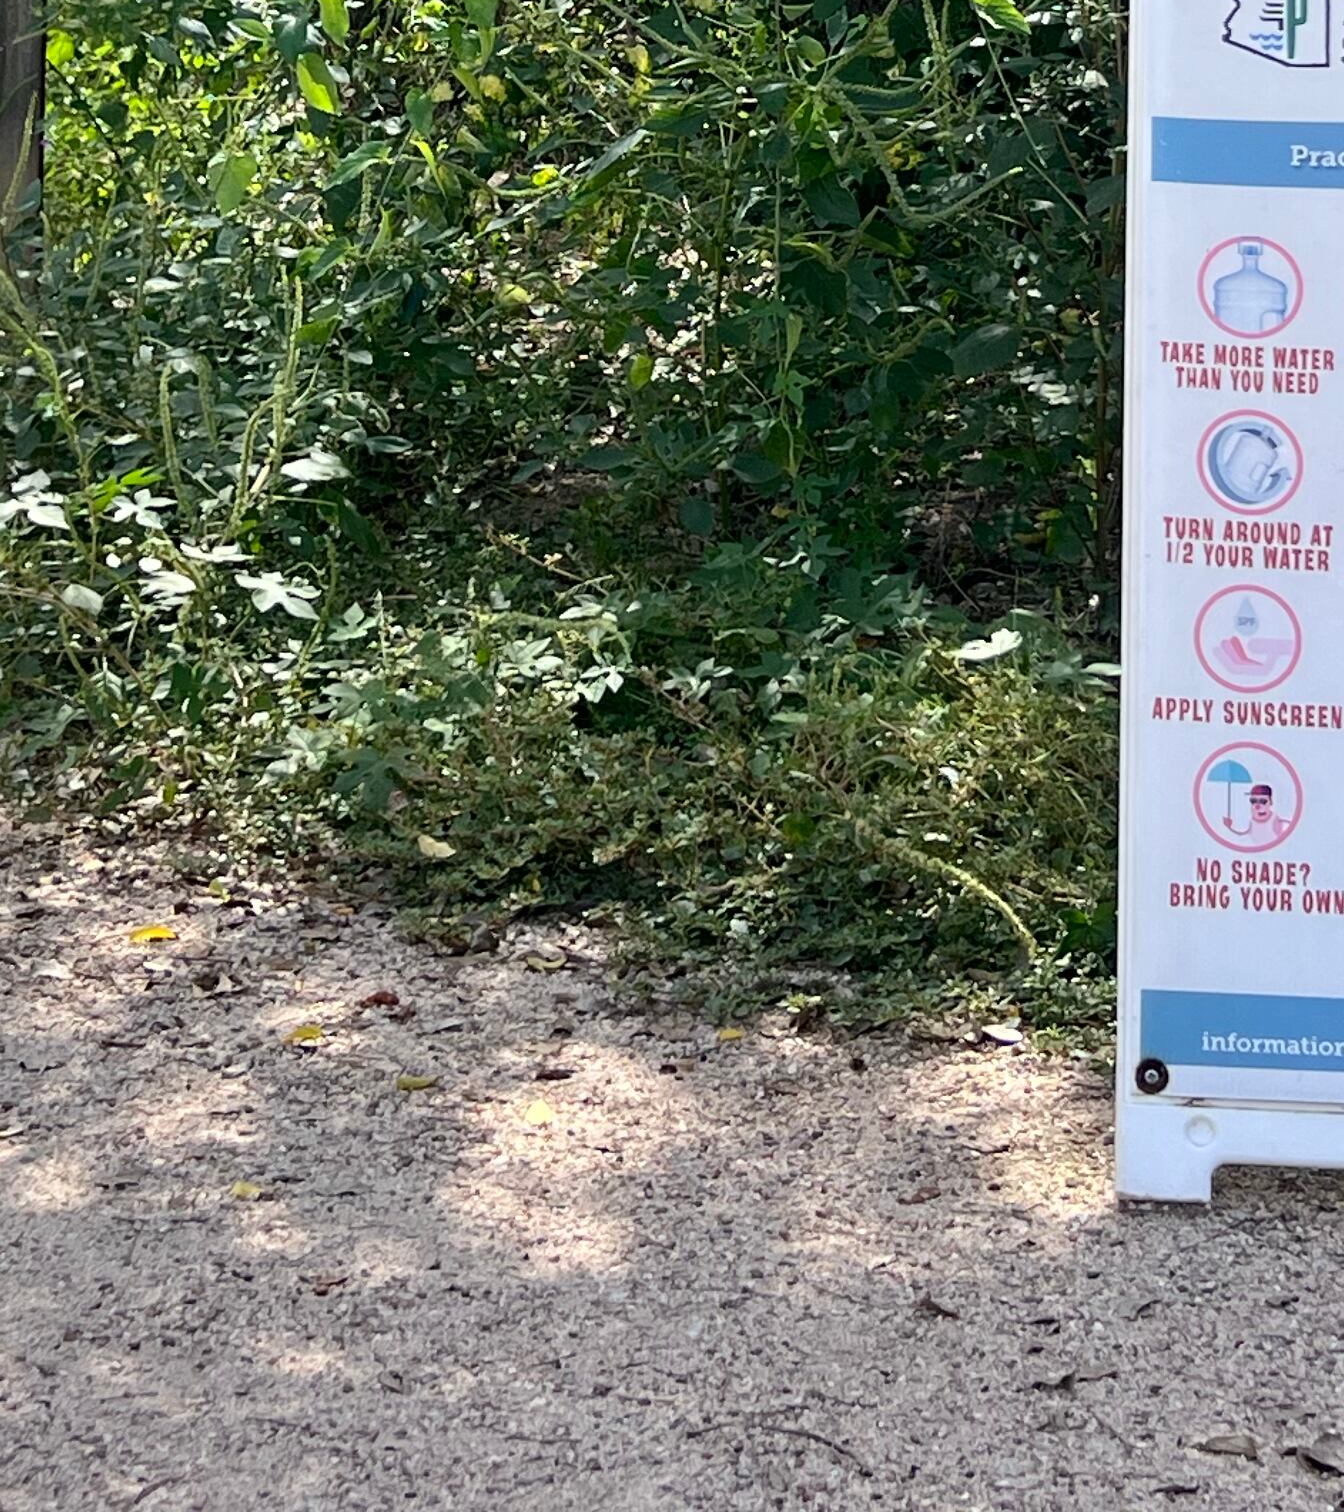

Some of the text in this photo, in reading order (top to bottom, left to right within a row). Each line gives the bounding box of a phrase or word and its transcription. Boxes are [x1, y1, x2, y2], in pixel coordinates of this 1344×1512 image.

[1160, 341, 1334, 370] TAKE MORE WATER
[1176, 366, 1318, 394] THAN YOU NEED
[1164, 517, 1333, 547] TURN AROUND AT
[1167, 542, 1328, 571] 1/2 YOUR WATER
[1237, 614, 1256, 628] SPF
[1152, 697, 1342, 729] APPLY SUNSCREEN
[1197, 858, 1310, 886] NO SHADE?
[1170, 883, 1344, 914] BRING YOUR OWN
